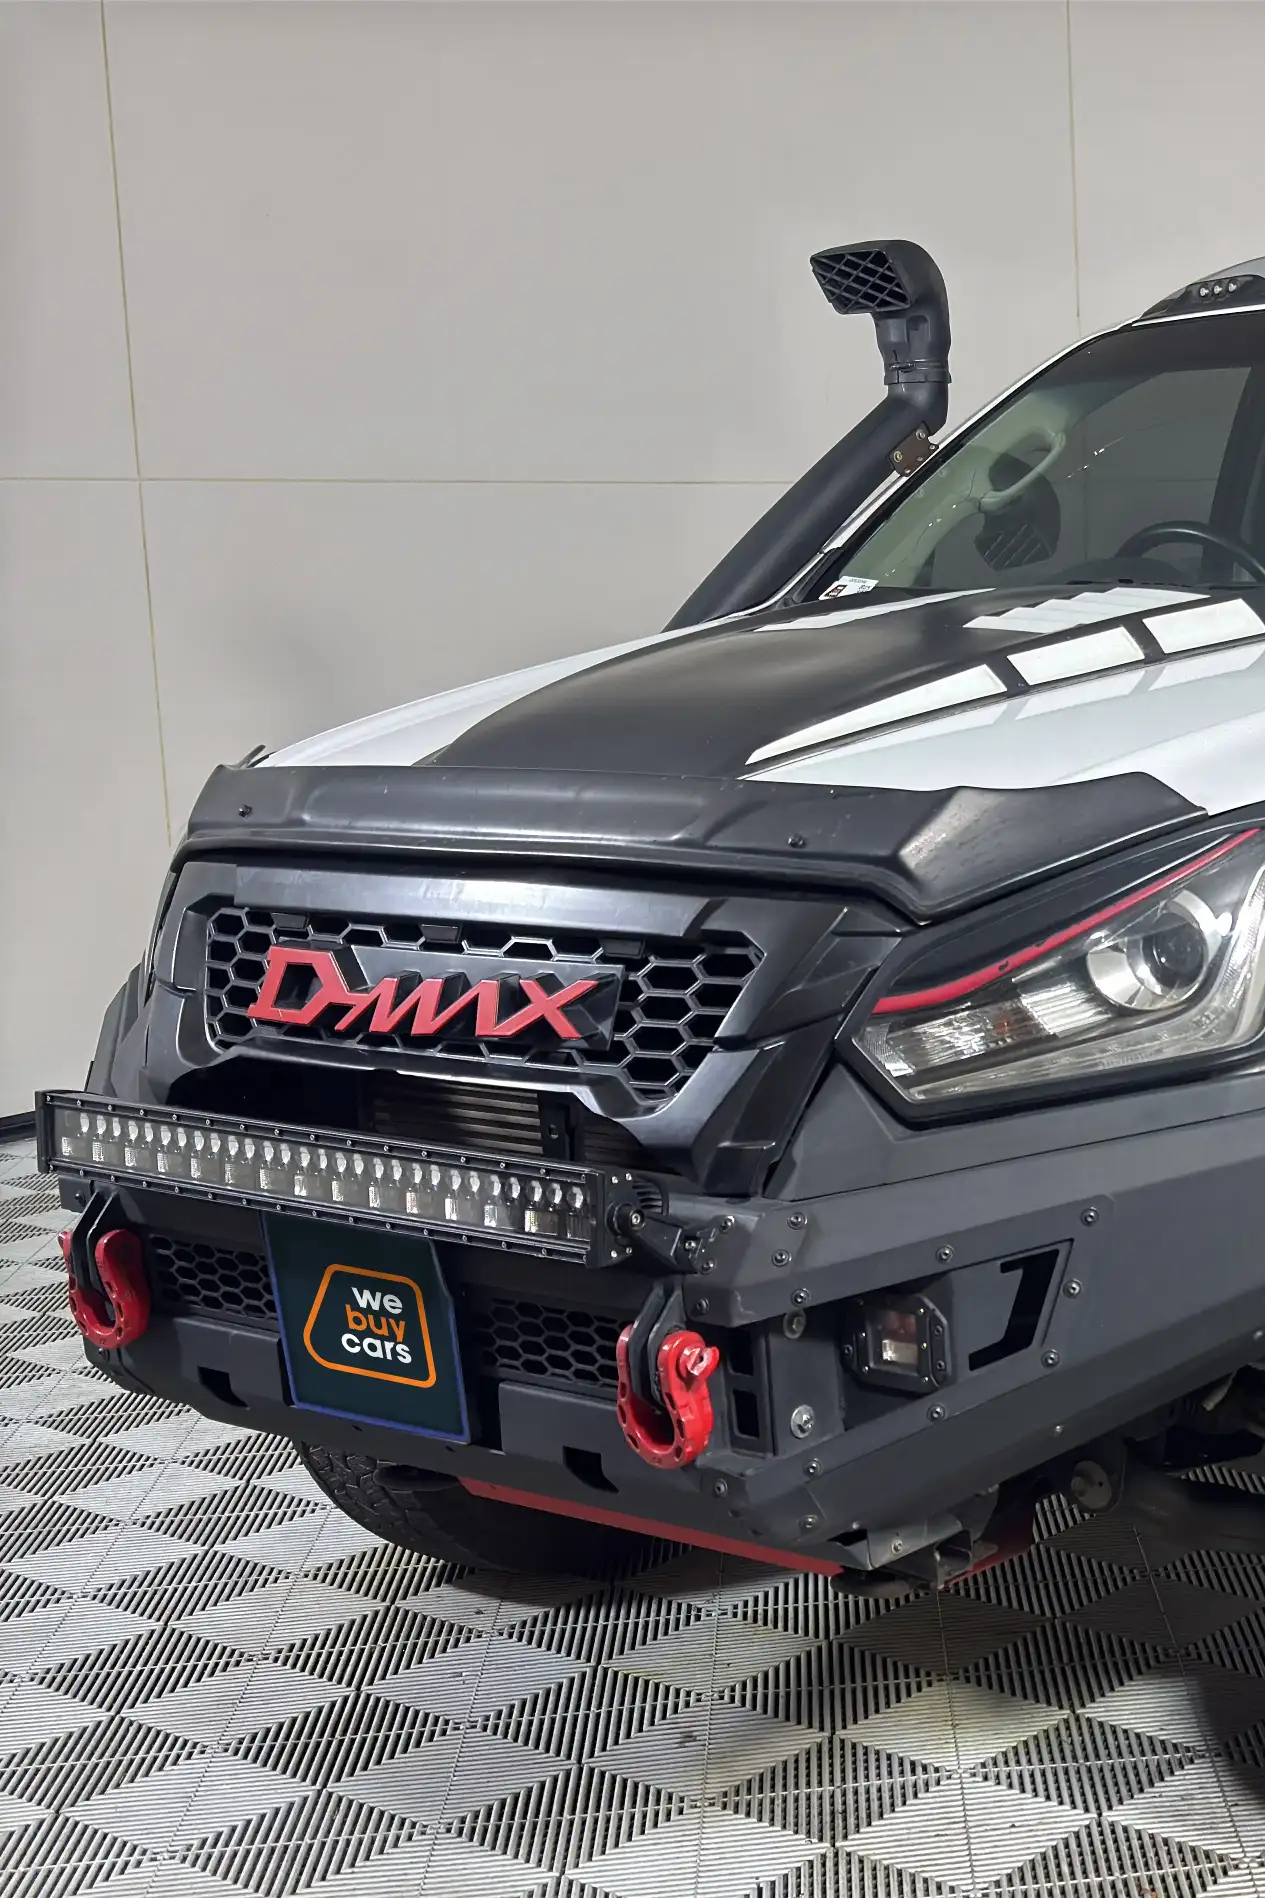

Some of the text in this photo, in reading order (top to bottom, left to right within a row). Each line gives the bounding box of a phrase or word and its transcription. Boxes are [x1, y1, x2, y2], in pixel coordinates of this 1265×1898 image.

[247, 945, 601, 1040] D-MAX
[351, 1286, 403, 1315] we
[345, 1304, 406, 1342] buy
[341, 1333, 412, 1364] cars
